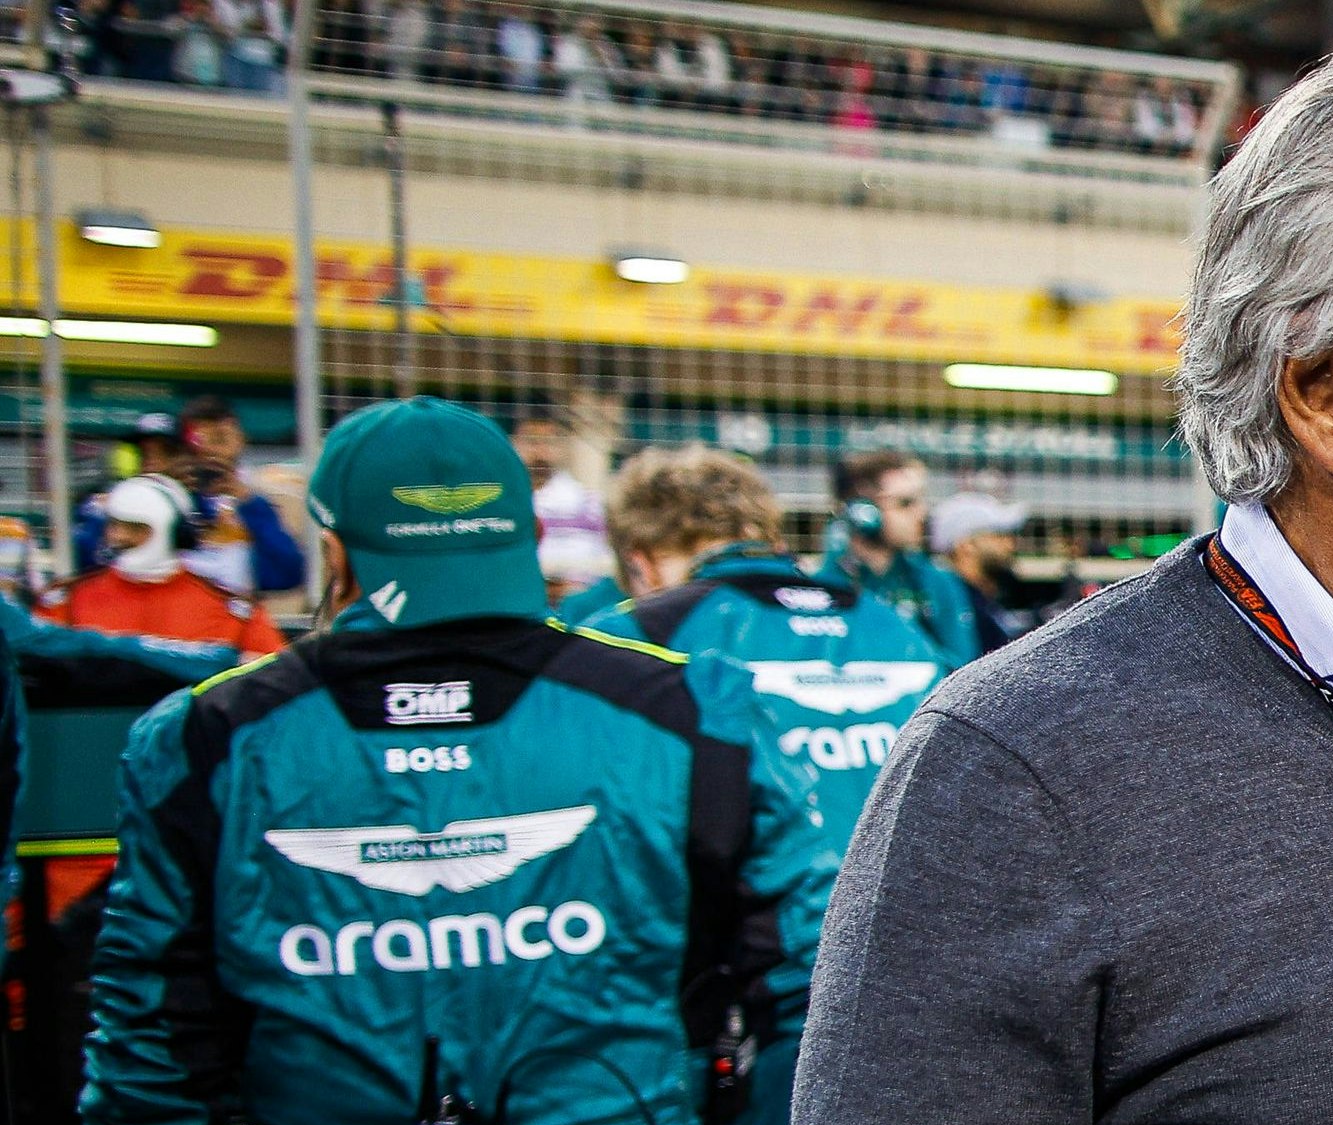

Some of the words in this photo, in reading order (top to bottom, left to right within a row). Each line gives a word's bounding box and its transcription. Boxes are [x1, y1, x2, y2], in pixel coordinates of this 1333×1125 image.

[705, 283, 940, 340] DHL
[385, 687, 472, 718] OMP
[384, 745, 472, 773] BOSS
[366, 843, 426, 860] ASTON
[429, 836, 504, 854] MARTIN
[280, 901, 606, 976] aramco
